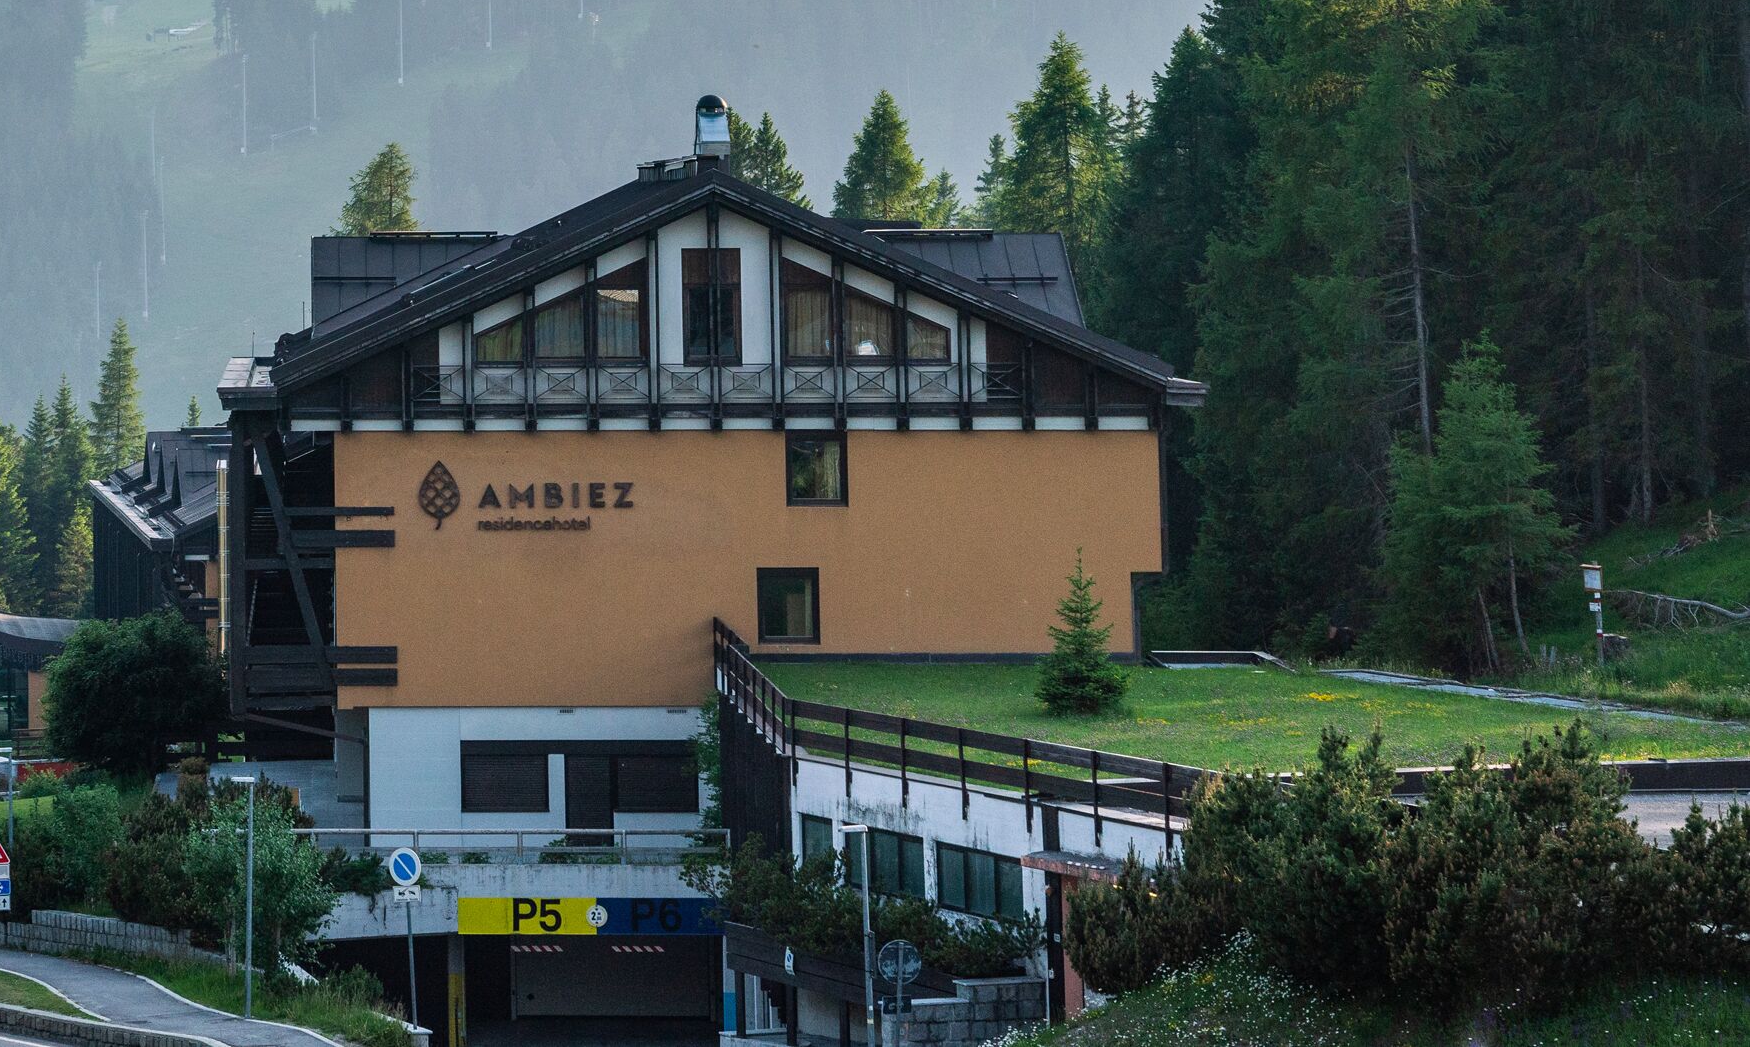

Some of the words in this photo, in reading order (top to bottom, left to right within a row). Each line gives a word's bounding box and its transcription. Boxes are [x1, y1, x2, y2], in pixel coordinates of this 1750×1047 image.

[478, 482, 634, 509] AMBIEZ
[478, 516, 591, 531] residencehotel
[513, 898, 562, 932] P5
[630, 898, 683, 932] P6
